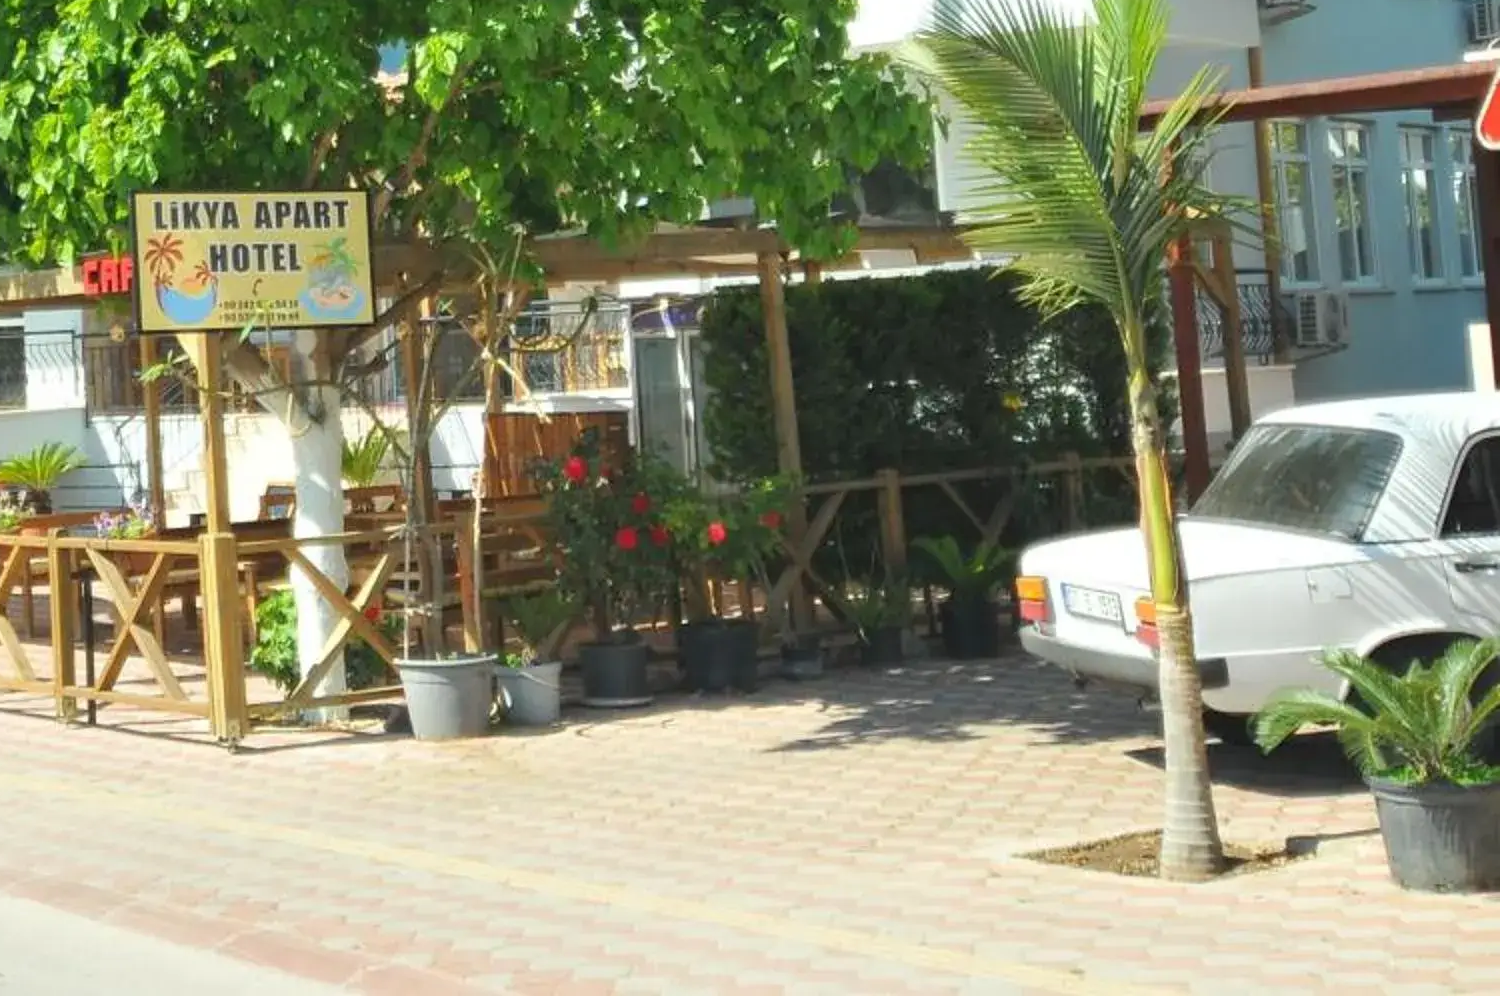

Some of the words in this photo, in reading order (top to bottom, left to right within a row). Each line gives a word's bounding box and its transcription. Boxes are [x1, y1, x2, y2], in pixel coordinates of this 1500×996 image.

[254, 199, 349, 229] APART
[209, 242, 301, 273] HOTEL
[84, 257, 132, 295] CAF
